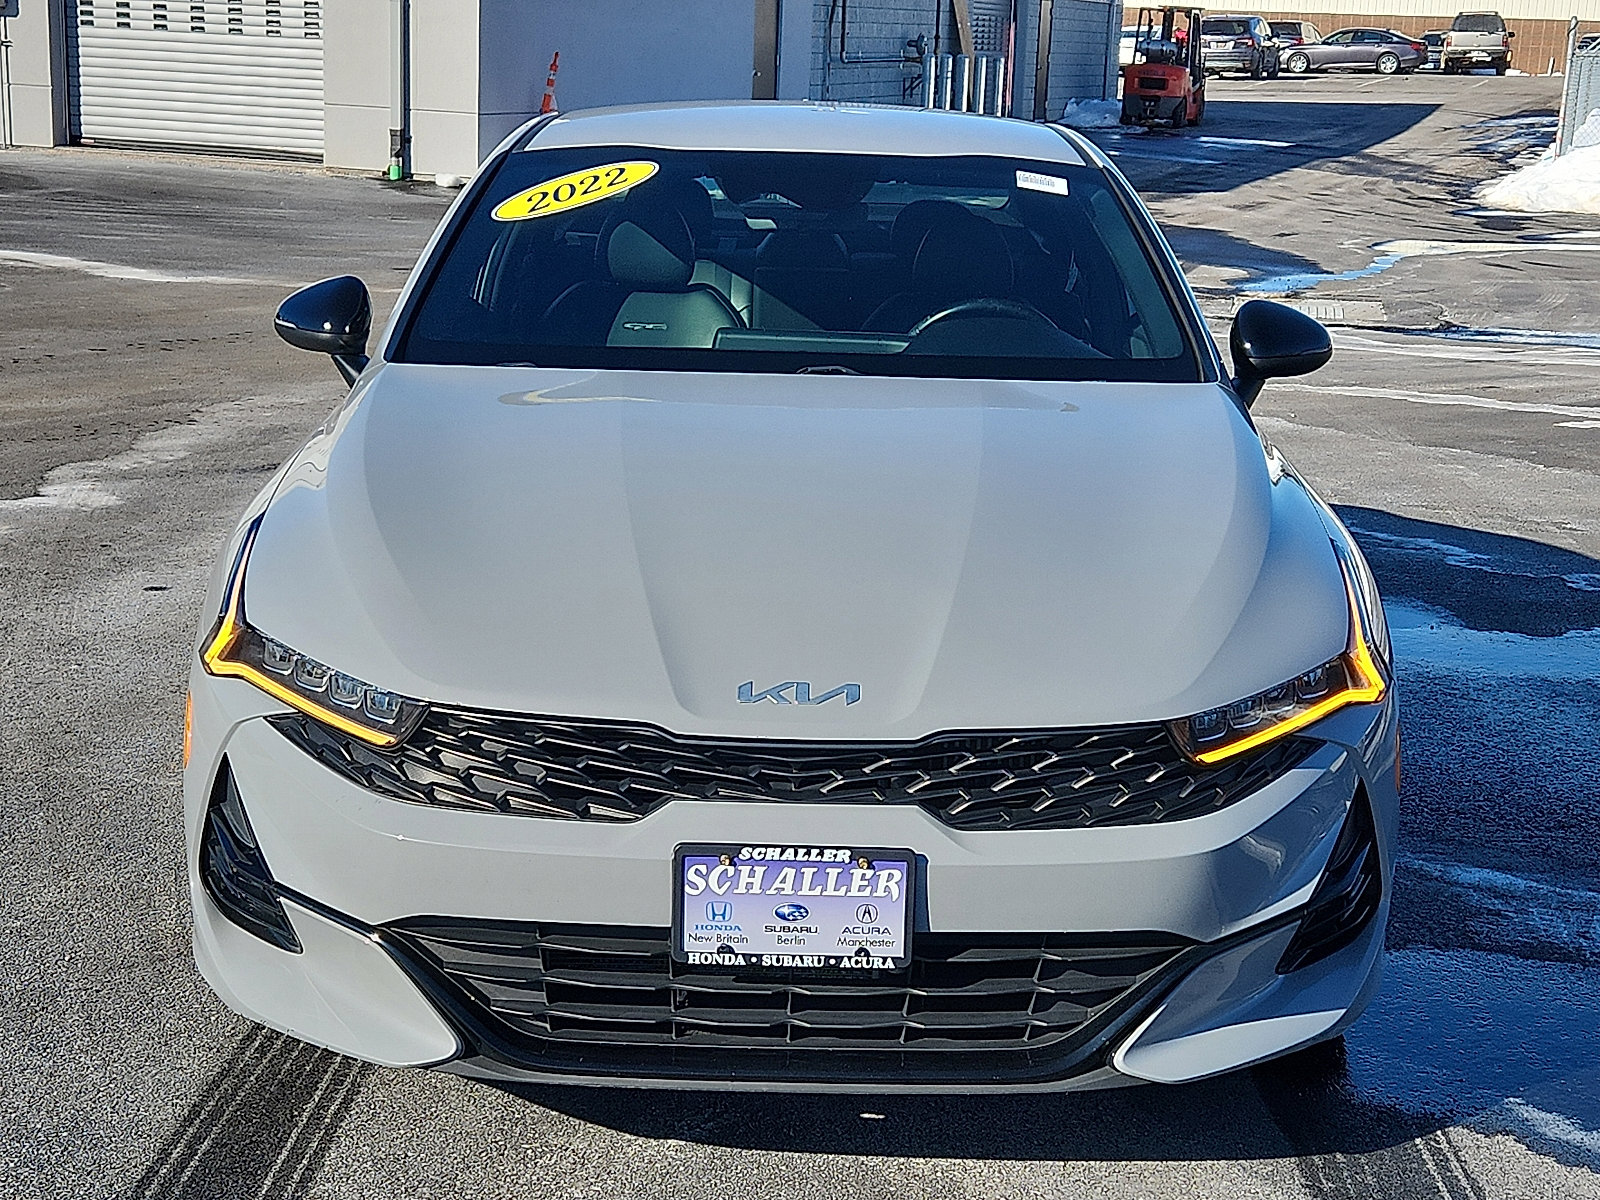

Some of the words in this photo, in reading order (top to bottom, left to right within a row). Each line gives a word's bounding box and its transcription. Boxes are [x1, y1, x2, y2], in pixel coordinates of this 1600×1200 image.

[526, 167, 629, 214] 2022
[737, 680, 862, 706] KIA
[738, 846, 852, 864] SCHALLER
[684, 864, 903, 902] SCHALLER
[694, 924, 742, 932] HONDA
[764, 925, 819, 934] SUBARU
[841, 926, 892, 935] ACURA
[688, 932, 713, 943] New
[716, 933, 749, 944] Britain
[776, 935, 806, 946] Berlin
[836, 936, 896, 948] Manchester
[687, 952, 747, 966] HONDA
[761, 954, 826, 968] SUBARU
[839, 956, 896, 969] ACURA
